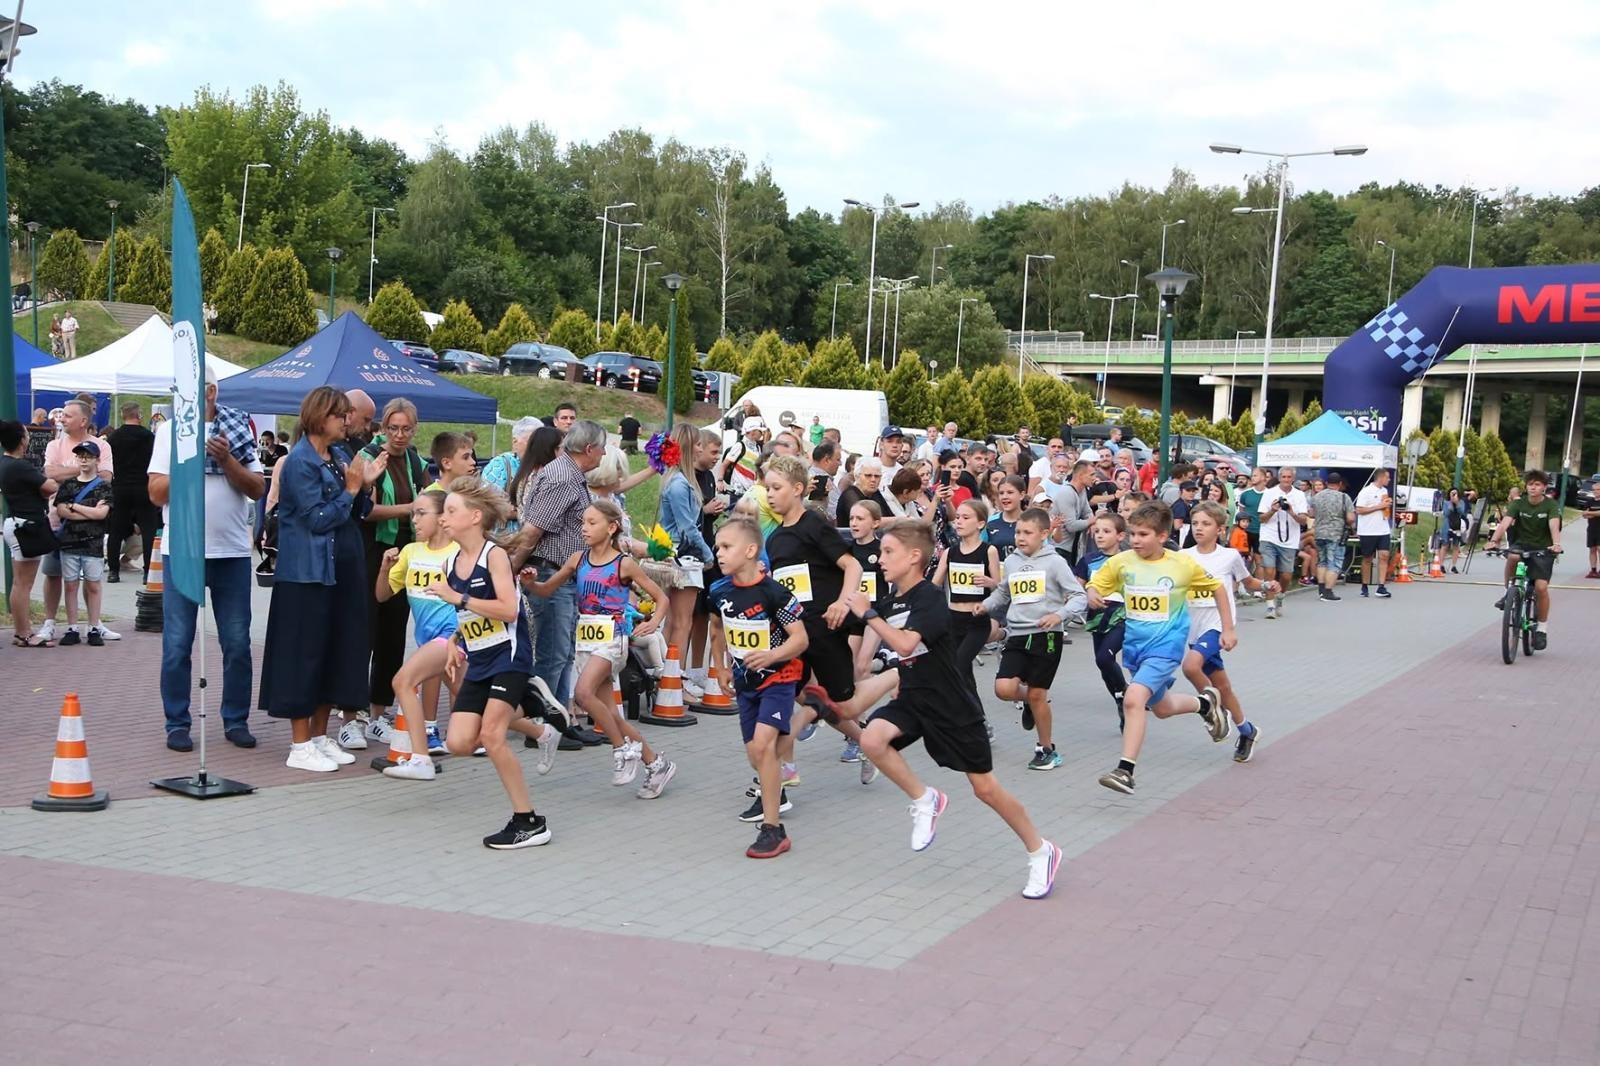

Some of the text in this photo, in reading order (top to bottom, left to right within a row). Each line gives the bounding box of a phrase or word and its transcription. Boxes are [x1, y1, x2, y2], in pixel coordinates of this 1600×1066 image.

[363, 363, 416, 375] BROWAR
[1343, 415, 1388, 432] osir
[860, 580, 868, 593] 5
[1013, 580, 1037, 594] 108
[1130, 595, 1160, 611] 103
[464, 618, 494, 640] 104
[580, 624, 605, 640] 106
[728, 630, 760, 648] 110
